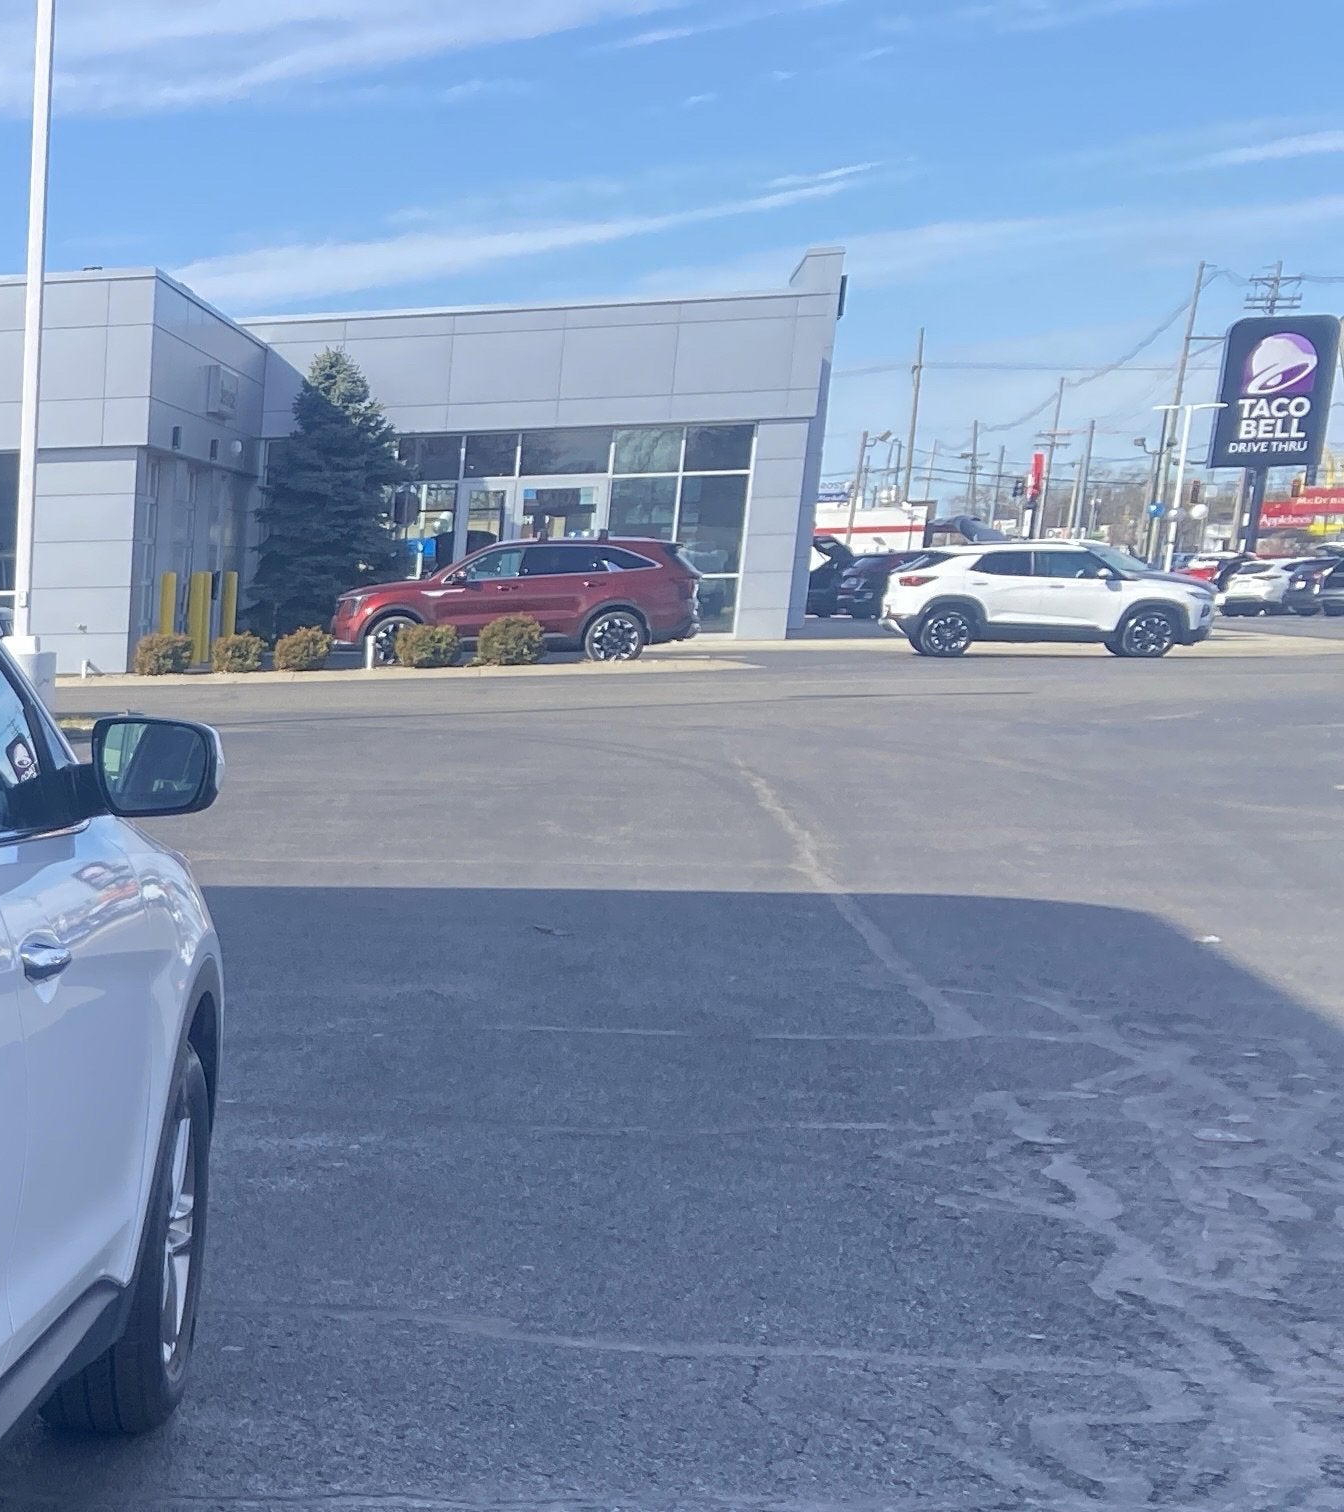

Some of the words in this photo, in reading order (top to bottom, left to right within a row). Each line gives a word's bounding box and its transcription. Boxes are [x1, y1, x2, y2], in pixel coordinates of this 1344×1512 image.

[1238, 397, 1311, 418] TACO
[1238, 418, 1306, 439] BELL
[1228, 442, 1269, 454] DRIVE
[1272, 440, 1308, 452] THRU
